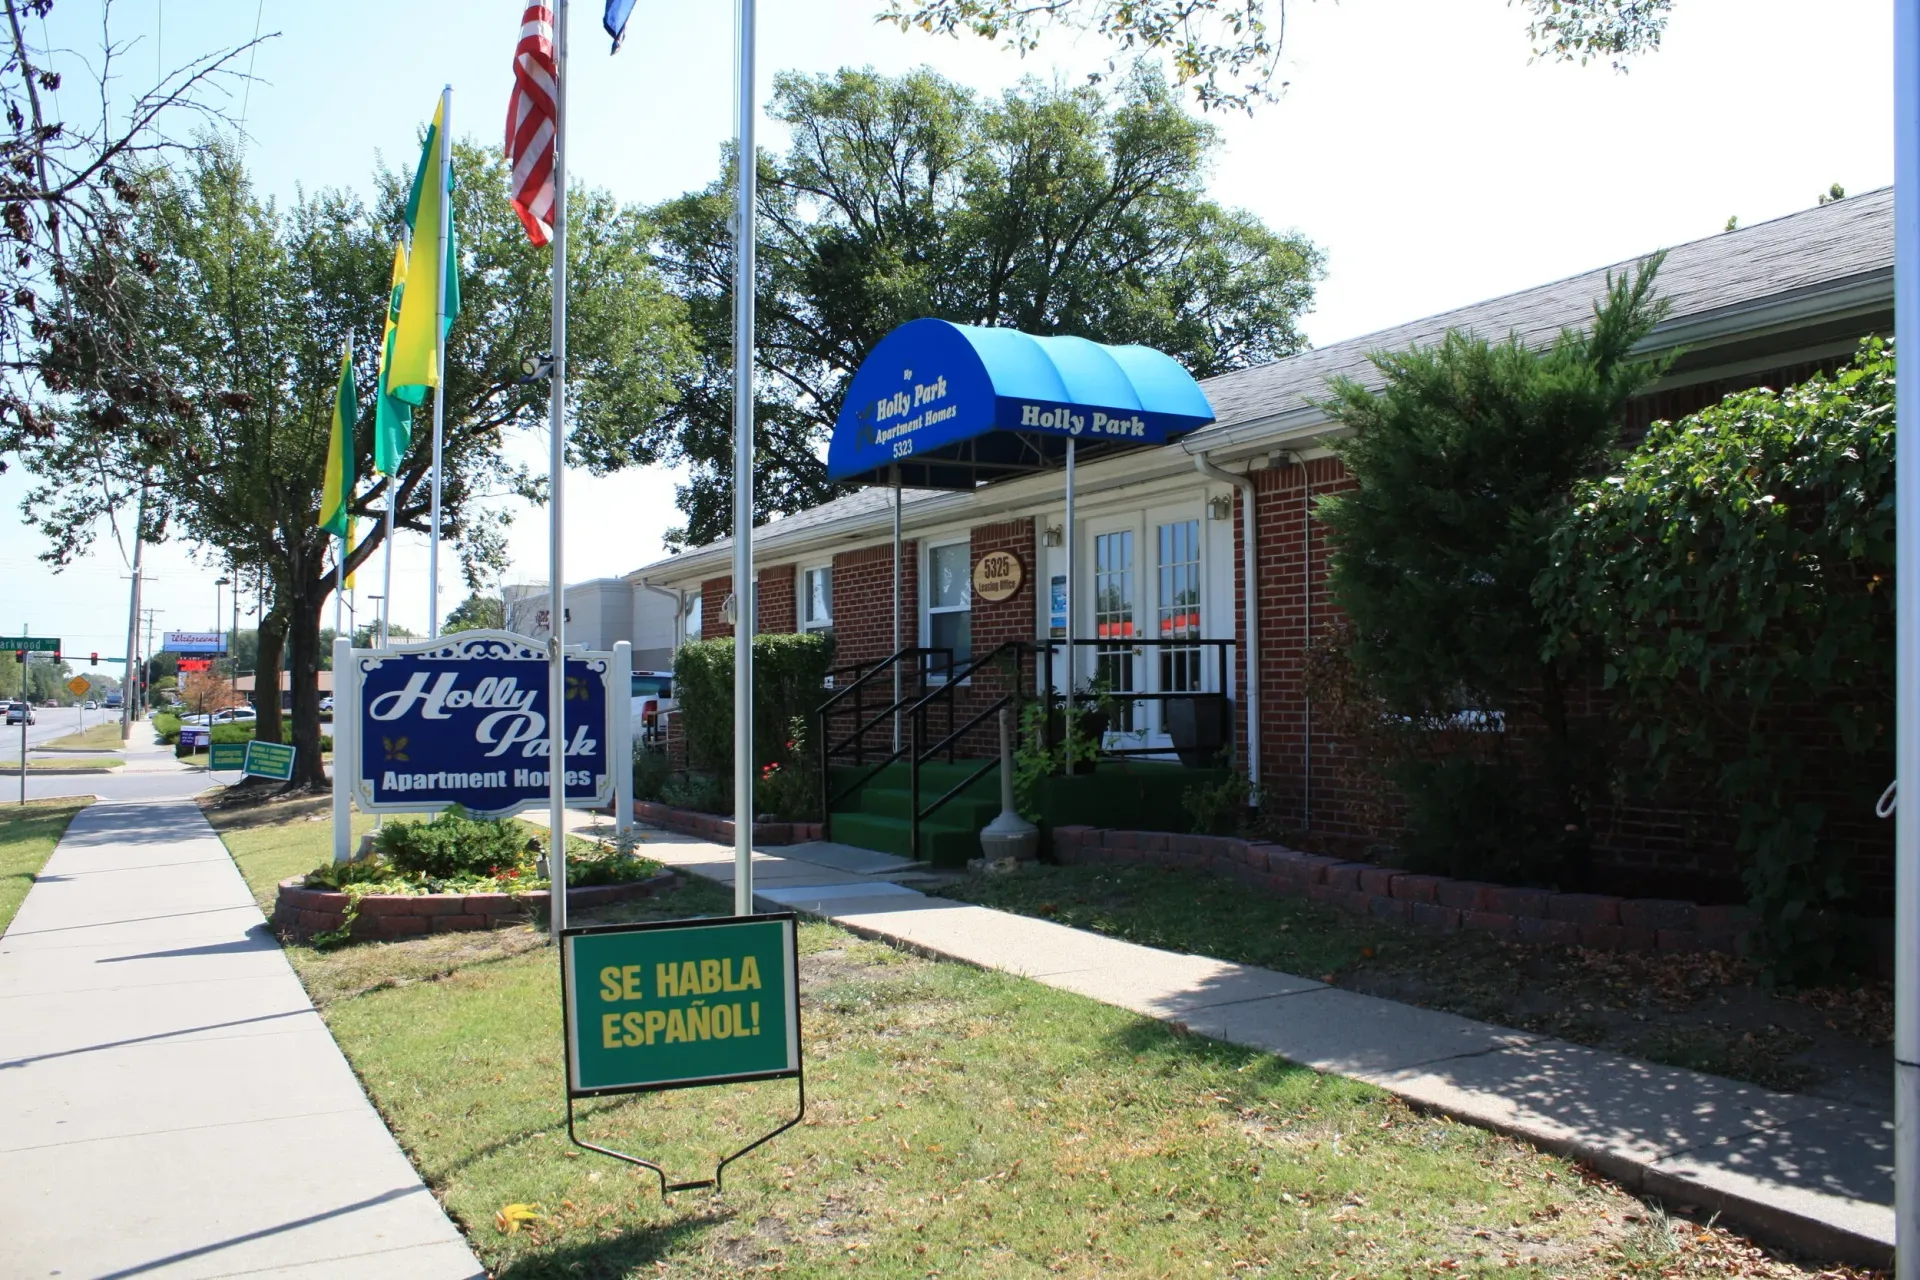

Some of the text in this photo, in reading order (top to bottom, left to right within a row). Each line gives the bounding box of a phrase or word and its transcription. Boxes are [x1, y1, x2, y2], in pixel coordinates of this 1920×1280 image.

[876, 374, 947, 422] Holly Park
[875, 405, 957, 445] Apartment Homes
[1020, 405, 1145, 437] Holly Park
[892, 438, 913, 459] 5323
[984, 556, 1009, 579] 5325
[171, 634, 219, 645] Walgreens
[369, 672, 538, 720] Holly
[382, 770, 507, 792] Apartment
[599, 955, 762, 1003] SE HABLA
[601, 1000, 761, 1049] ESPAÑOL!
